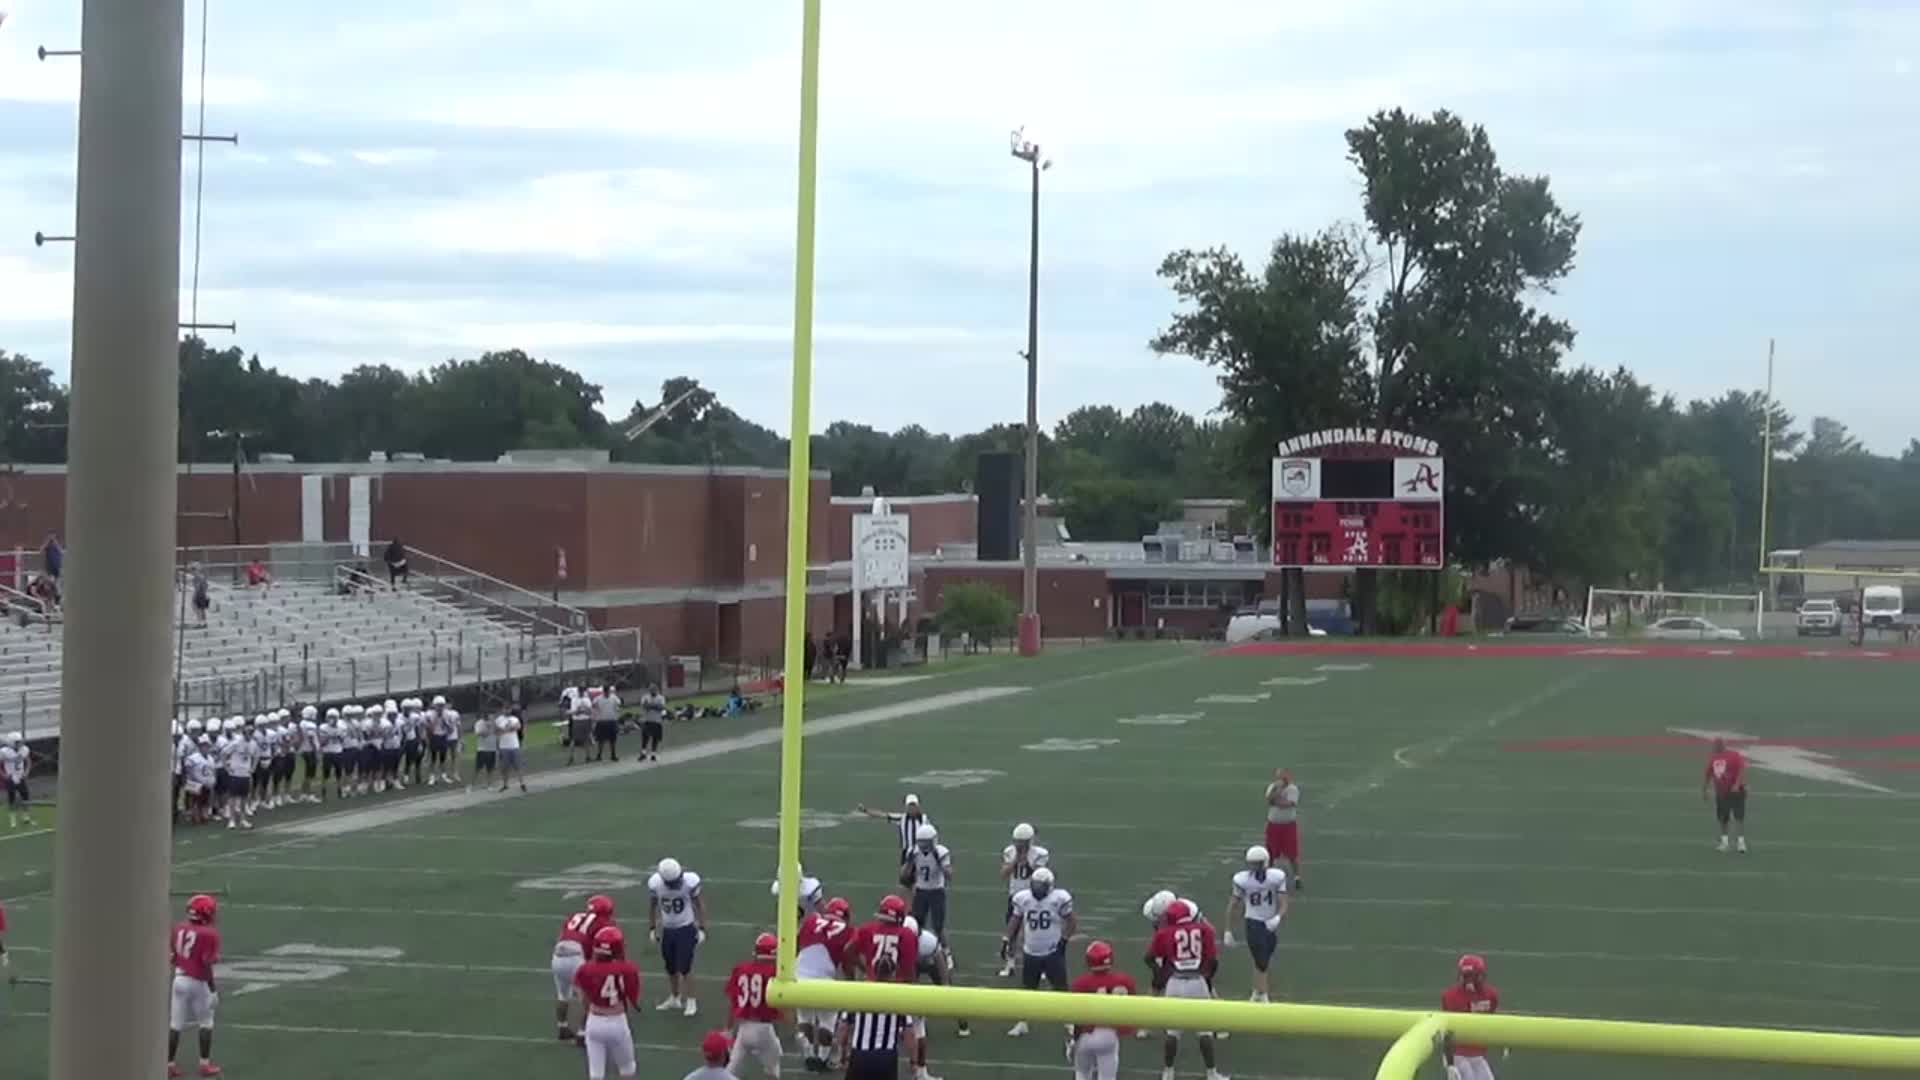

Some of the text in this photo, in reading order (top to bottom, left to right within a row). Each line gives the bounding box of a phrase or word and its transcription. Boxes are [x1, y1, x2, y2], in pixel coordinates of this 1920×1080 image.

[1278, 427, 1440, 456] ANNANDALE ATOMS
[567, 912, 597, 935] 51
[176, 928, 197, 960] 12
[872, 933, 899, 968] 75
[1174, 928, 1203, 959] 26
[737, 973, 763, 1009] 39
